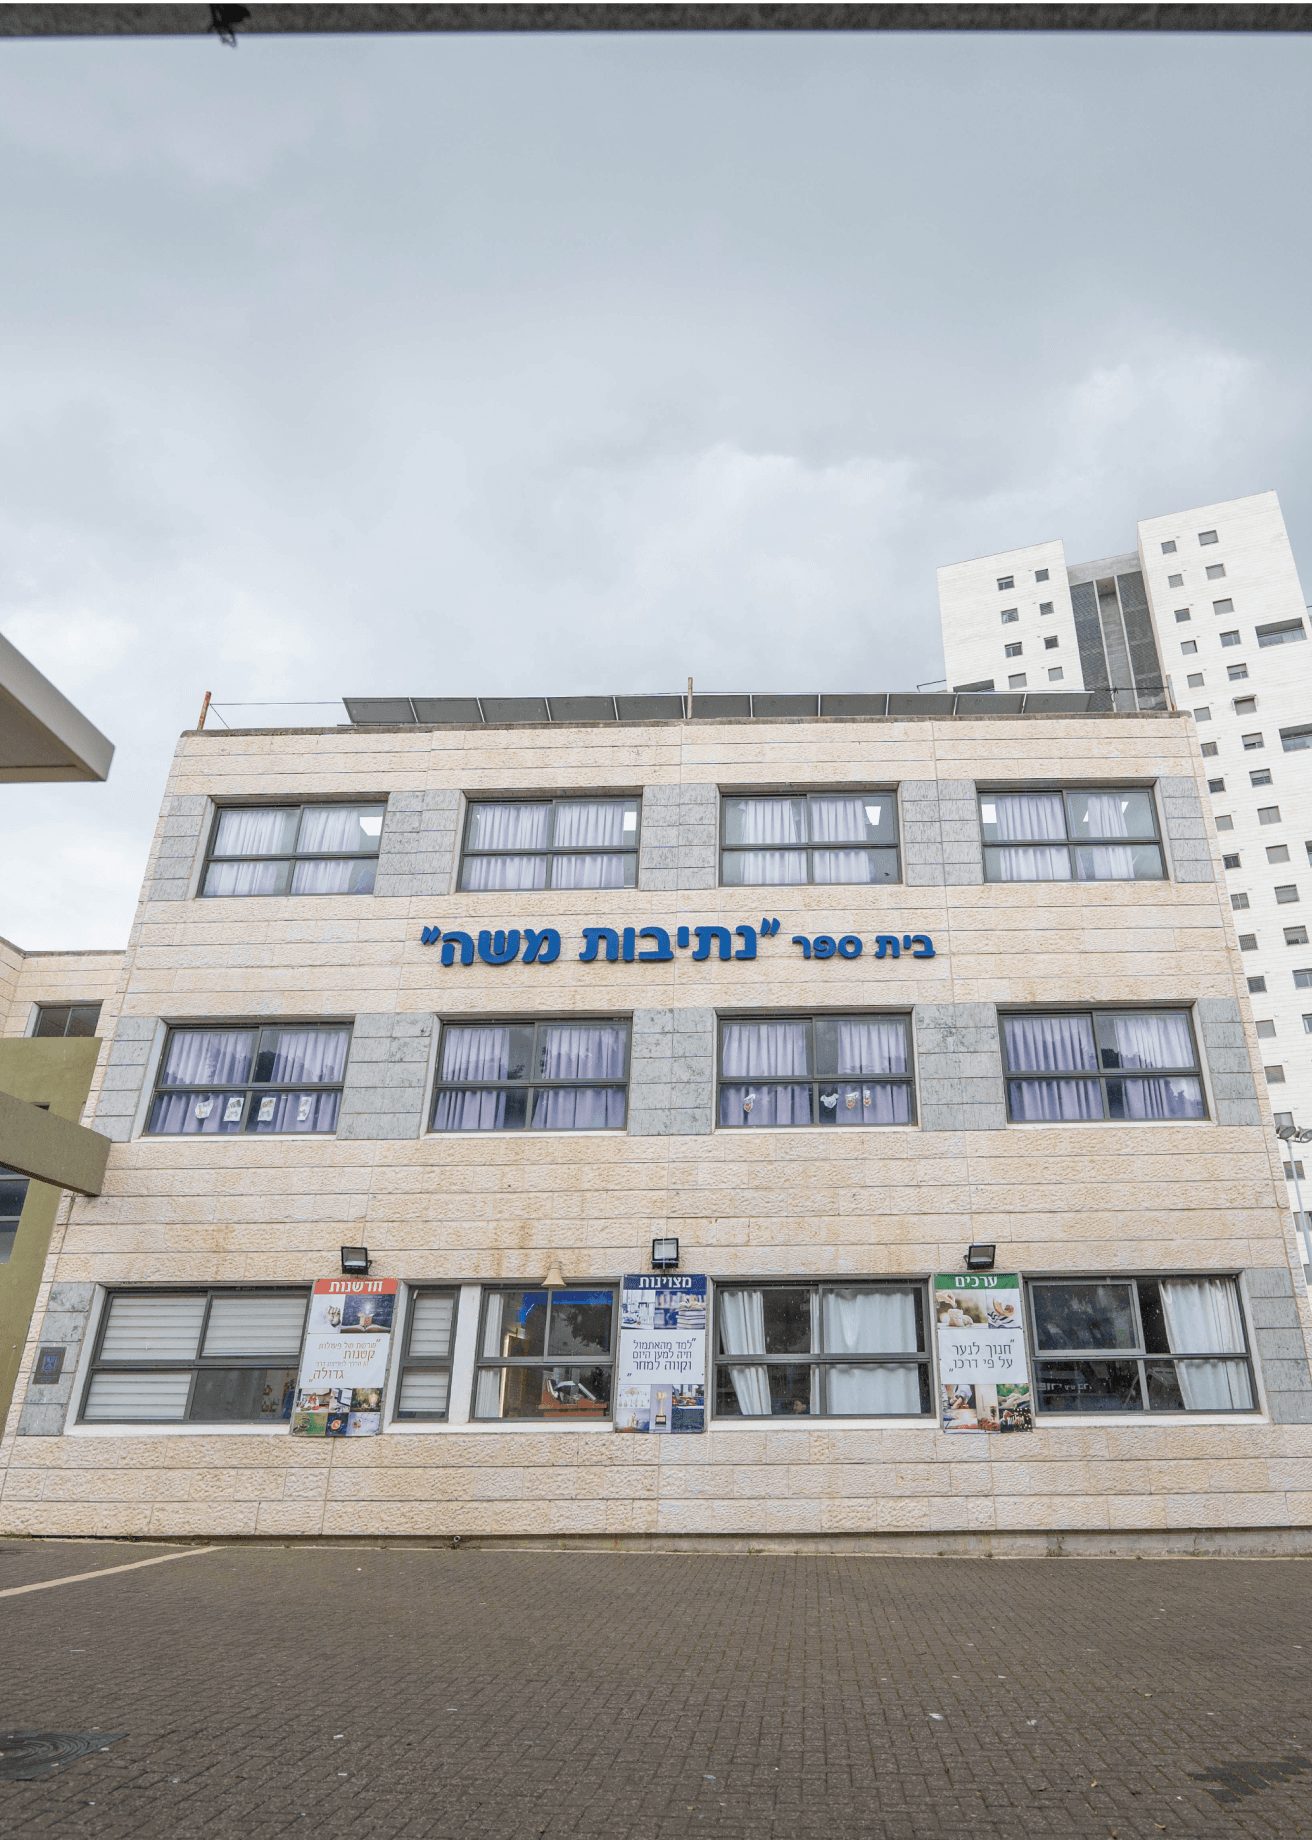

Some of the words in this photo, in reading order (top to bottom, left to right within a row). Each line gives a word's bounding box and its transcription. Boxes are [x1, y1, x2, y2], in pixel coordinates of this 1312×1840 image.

[792, 935, 863, 959] ספר
[875, 935, 936, 958] בית
[329, 1281, 383, 1293] חדשנות
[639, 1276, 692, 1288] מצוינות
[955, 1276, 998, 1288] ערכים
[344, 1342, 354, 1350] של
[633, 1340, 672, 1350] מהאתמול
[952, 1342, 980, 1356] לנער
[343, 1350, 376, 1361] קטנות
[633, 1351, 651, 1359] היום
[654, 1349, 674, 1363] למען
[677, 1351, 692, 1359] חיה
[665, 1361, 692, 1373] וקווה
[983, 1359, 995, 1369] פי
[998, 1356, 1013, 1369] על
